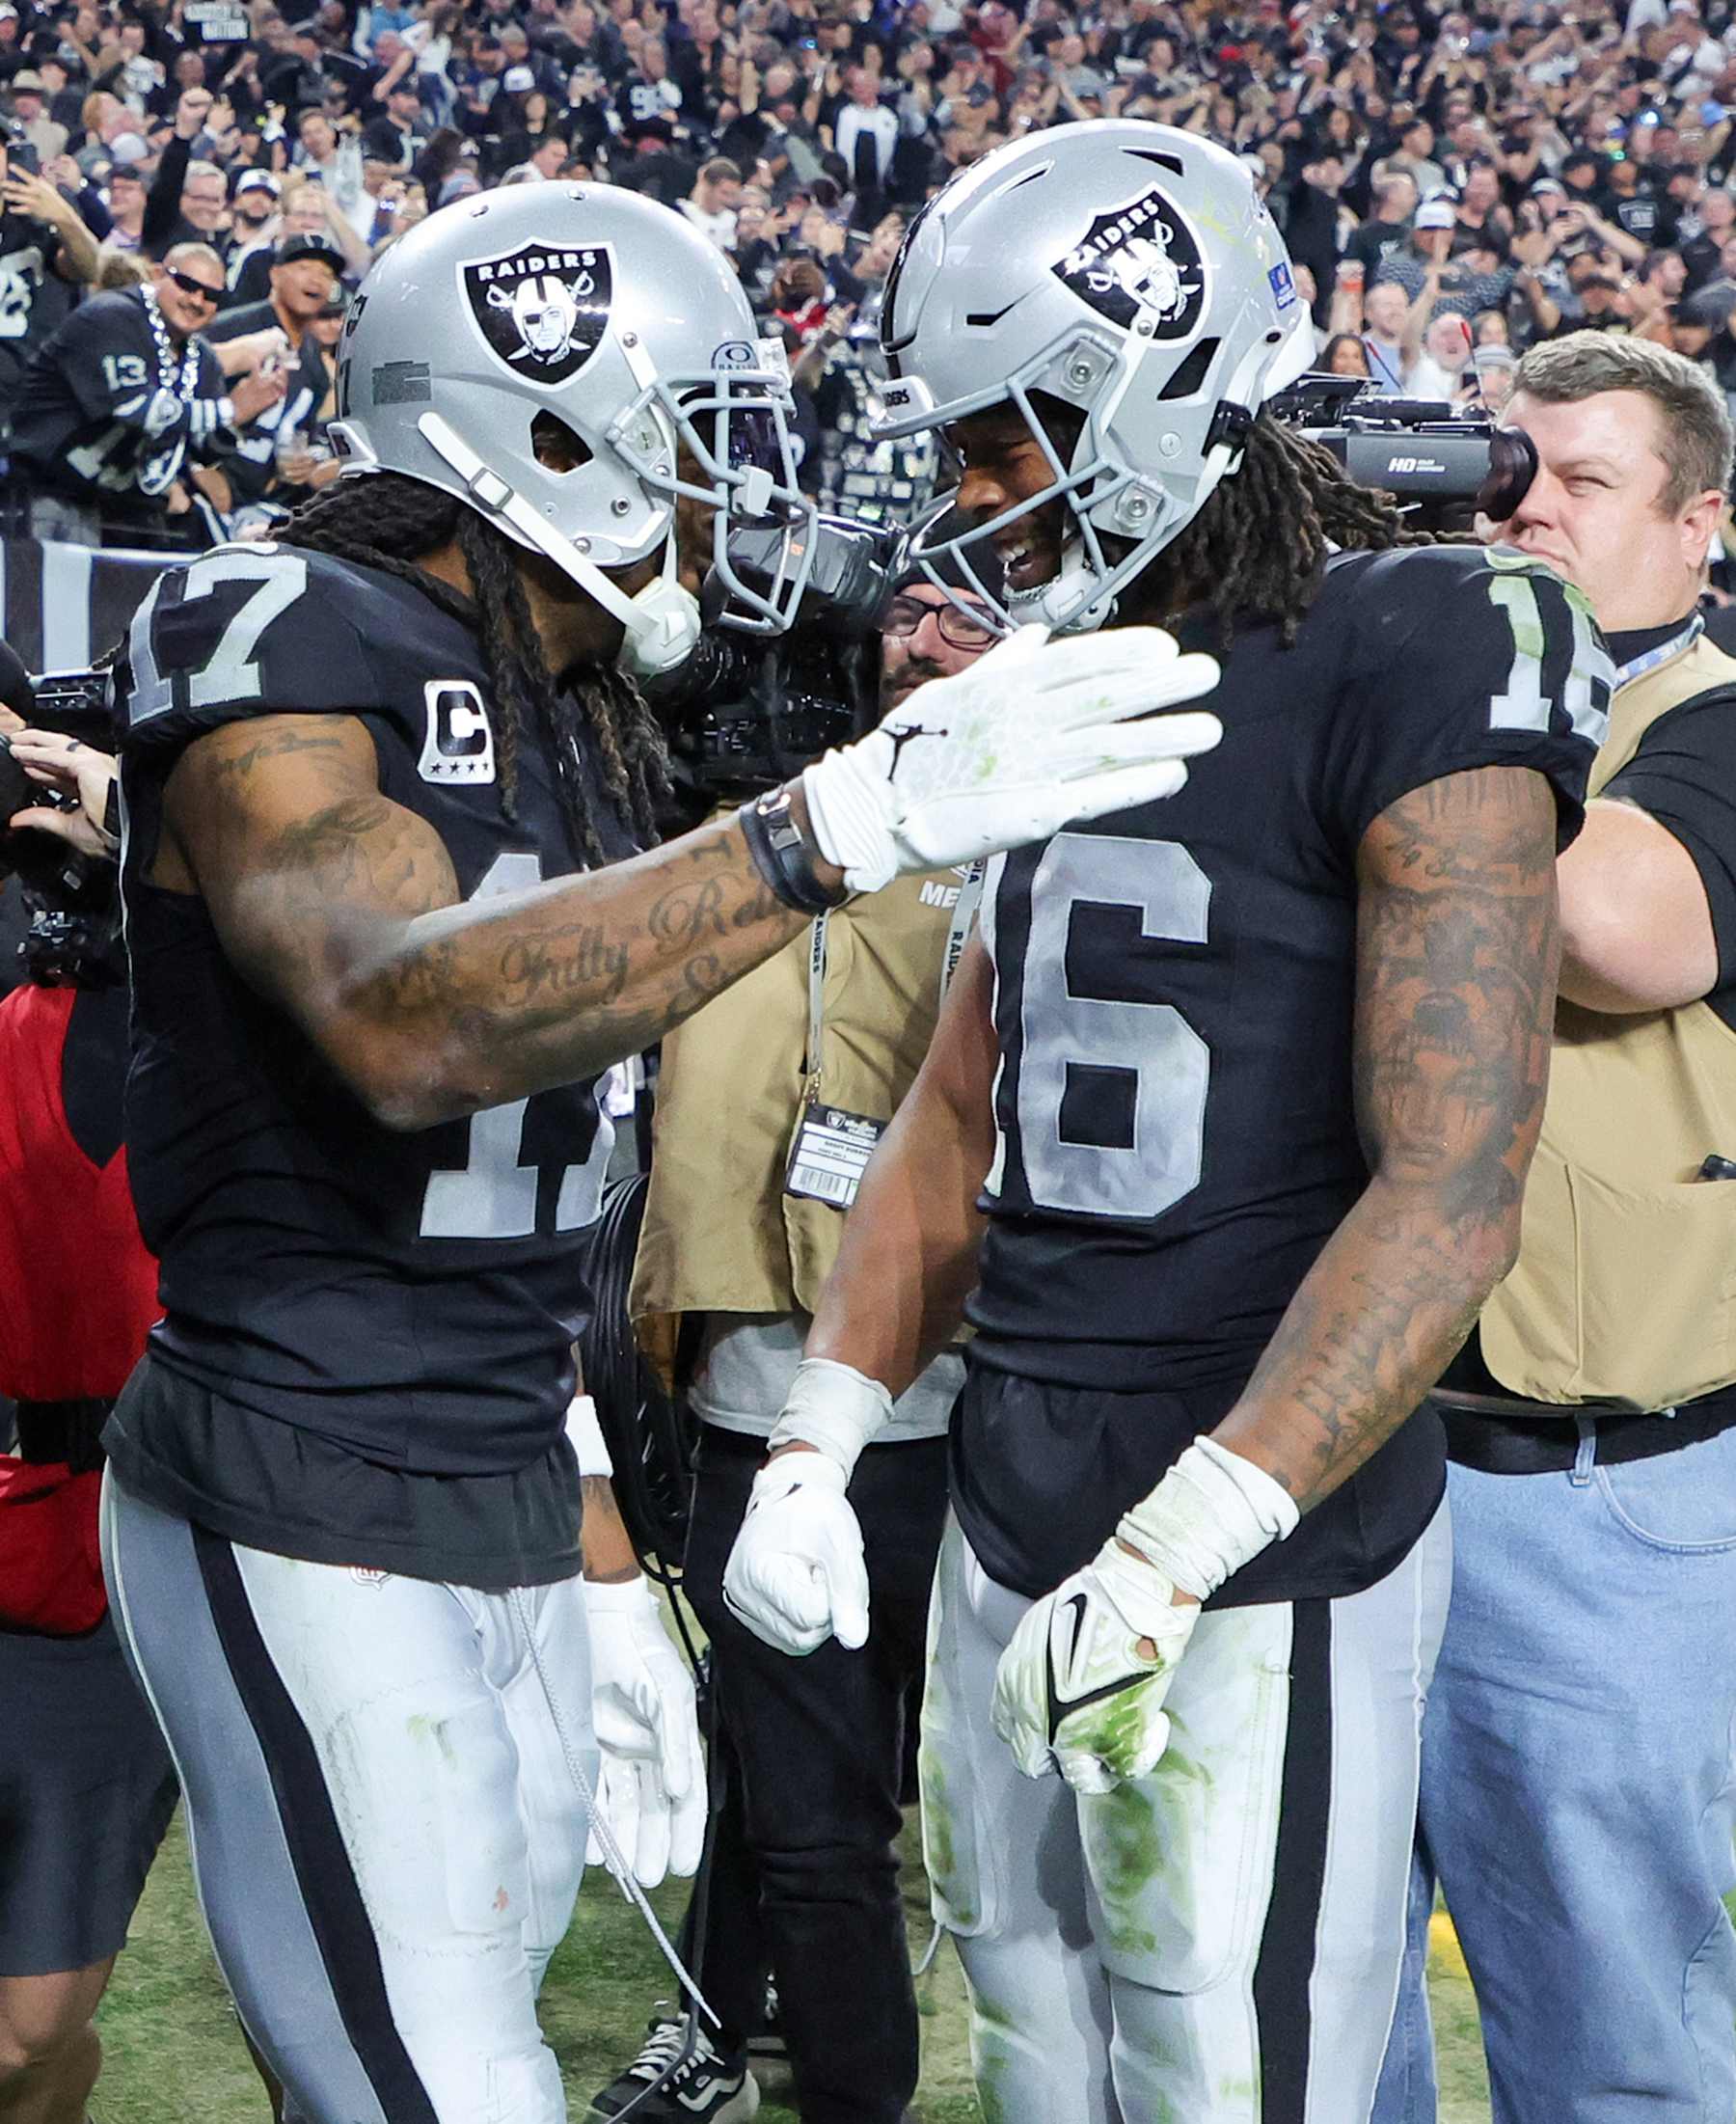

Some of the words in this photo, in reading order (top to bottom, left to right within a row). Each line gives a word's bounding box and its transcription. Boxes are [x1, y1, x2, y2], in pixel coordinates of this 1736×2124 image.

[478, 252, 596, 282] RAIDERS
[1063, 198, 1159, 275] RAIDERS
[101, 353, 149, 391] 13
[1388, 457, 1417, 473] HD
[127, 553, 308, 726] 17
[1488, 574, 1616, 747] 16
[437, 689, 487, 757] C
[812, 913, 824, 974] AIDERS
